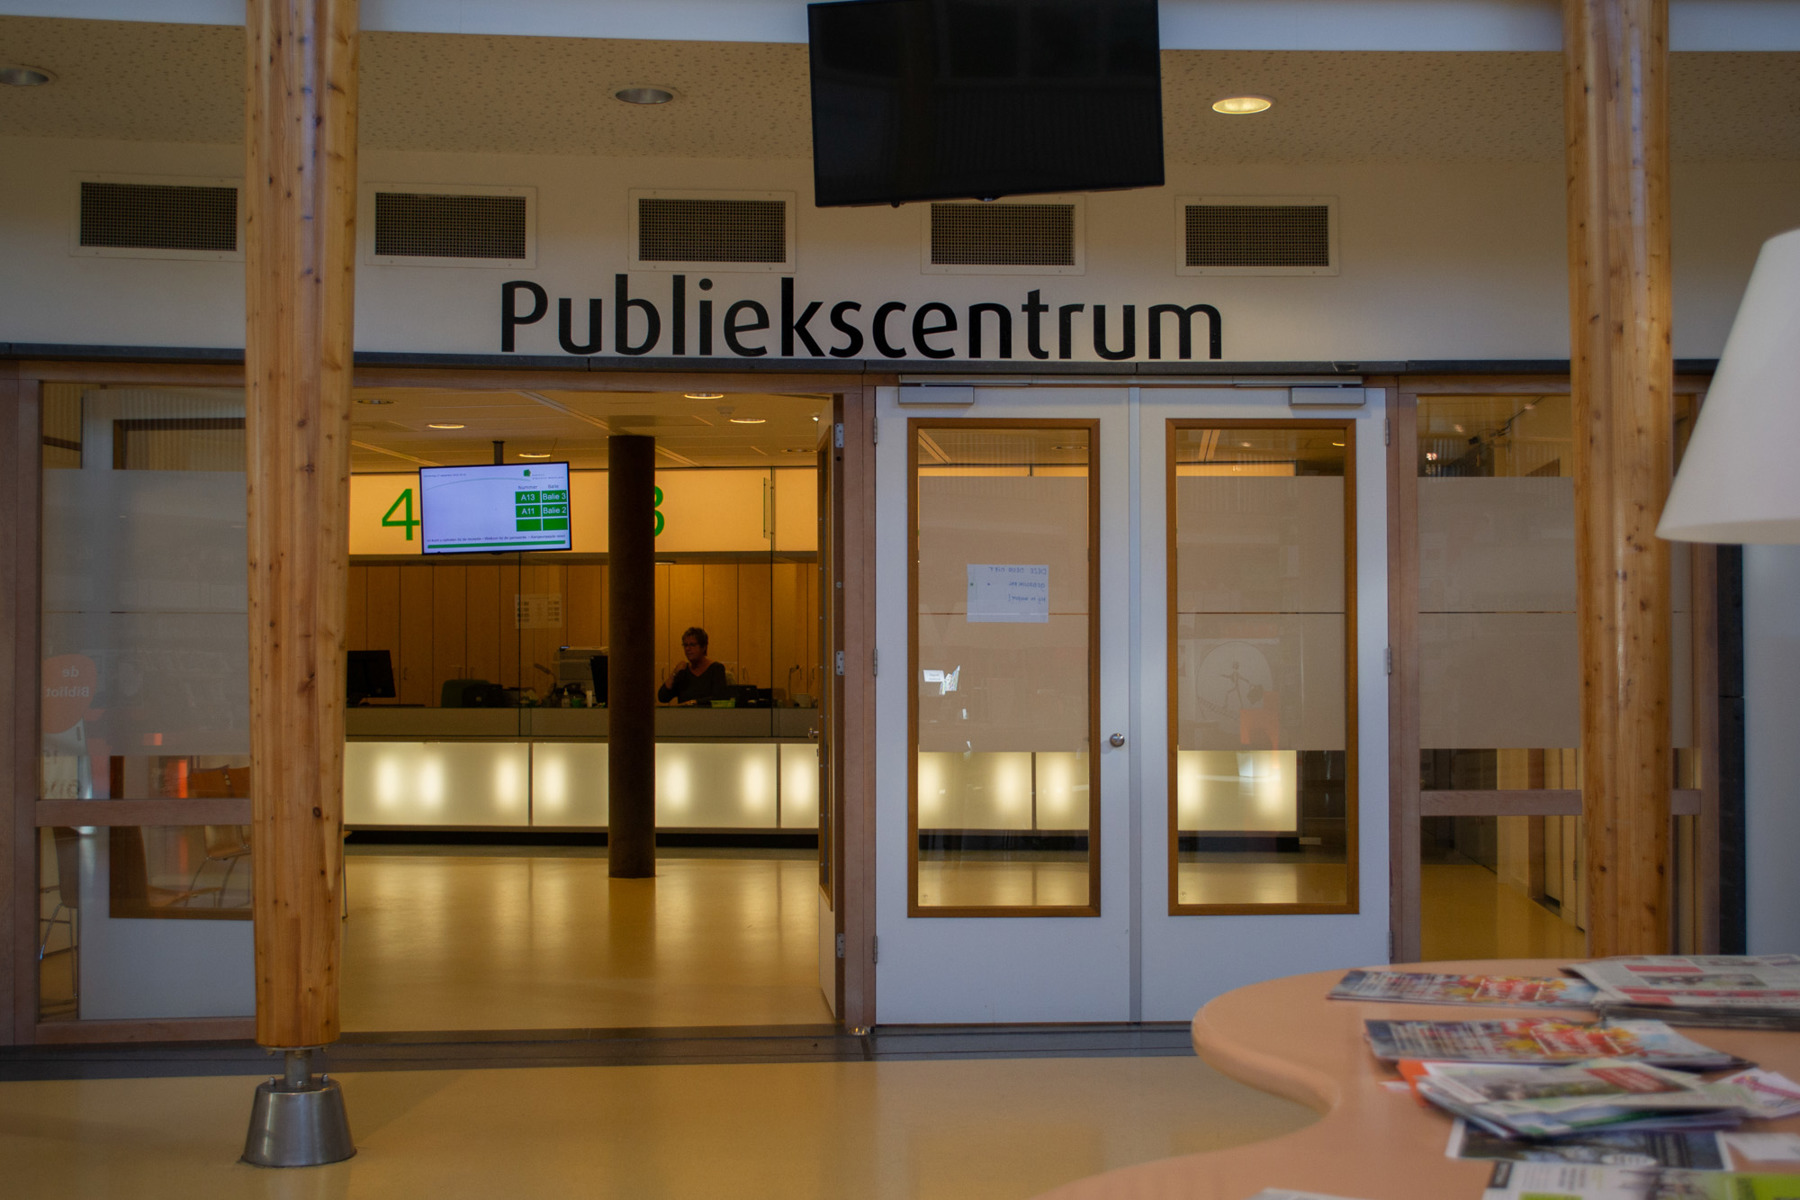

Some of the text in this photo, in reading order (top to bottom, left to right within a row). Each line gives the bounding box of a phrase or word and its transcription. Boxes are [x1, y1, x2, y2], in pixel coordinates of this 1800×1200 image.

[501, 274, 1223, 359] Publiekscentrum
[520, 493, 535, 501] A13
[542, 492, 567, 501] Balie 3
[382, 488, 420, 541] 4
[521, 507, 535, 515] A11
[543, 507, 560, 515] Balie
